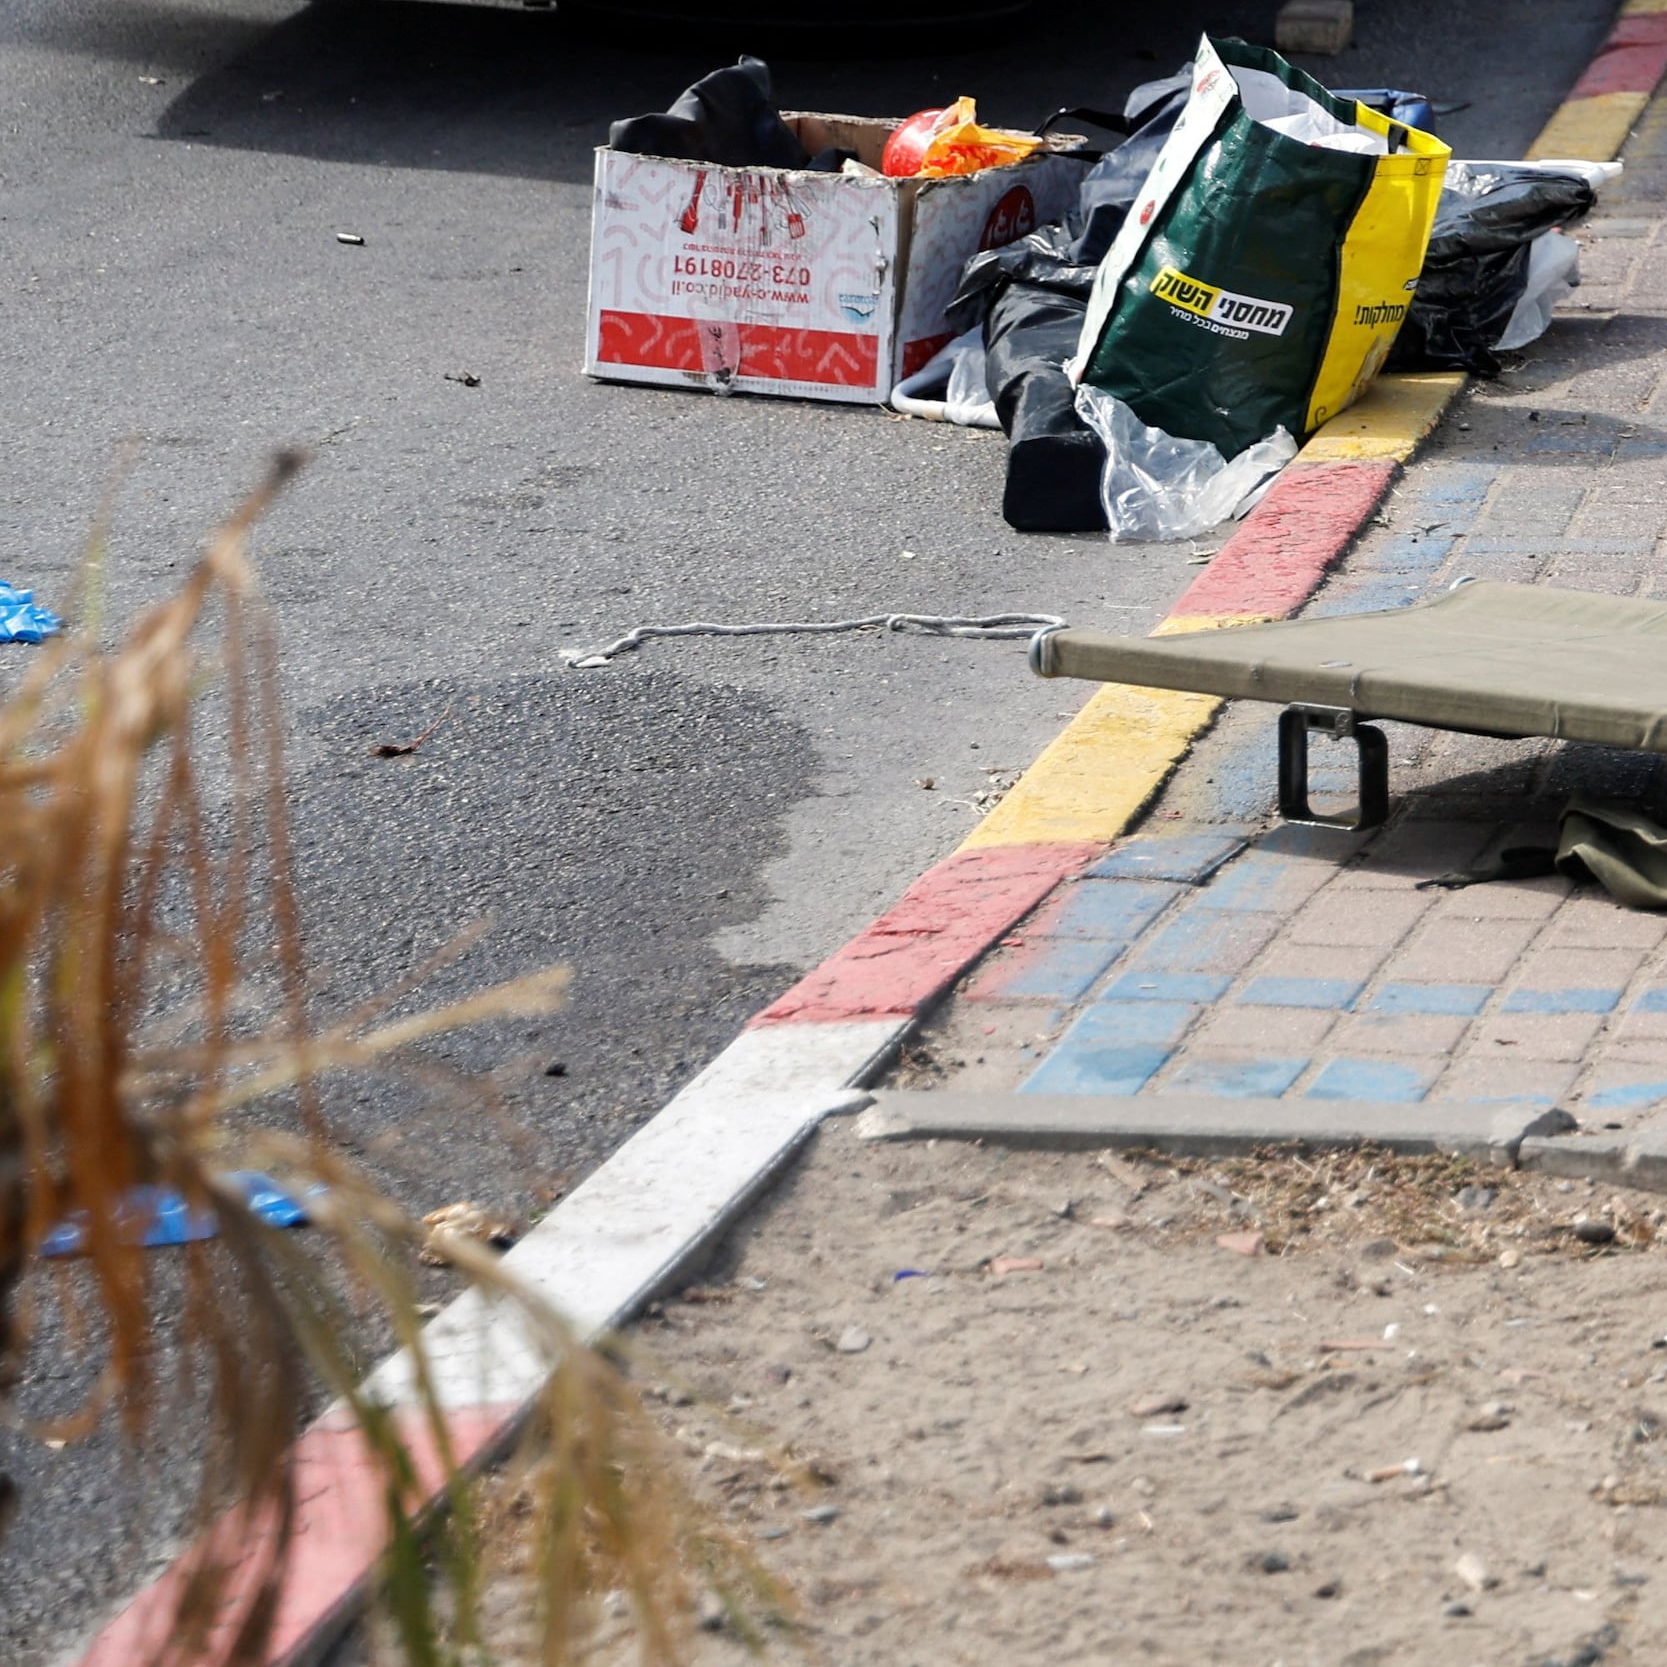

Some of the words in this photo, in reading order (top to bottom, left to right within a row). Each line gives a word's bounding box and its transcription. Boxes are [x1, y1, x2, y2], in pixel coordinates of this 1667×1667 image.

[674, 255, 811, 287] 073-2708191
[671, 281, 811, 305] www.c-yadid.co.il
[1152, 272, 1213, 311] השוק
[1170, 305, 1193, 322] מחיר
[1218, 297, 1286, 329] מחסני
